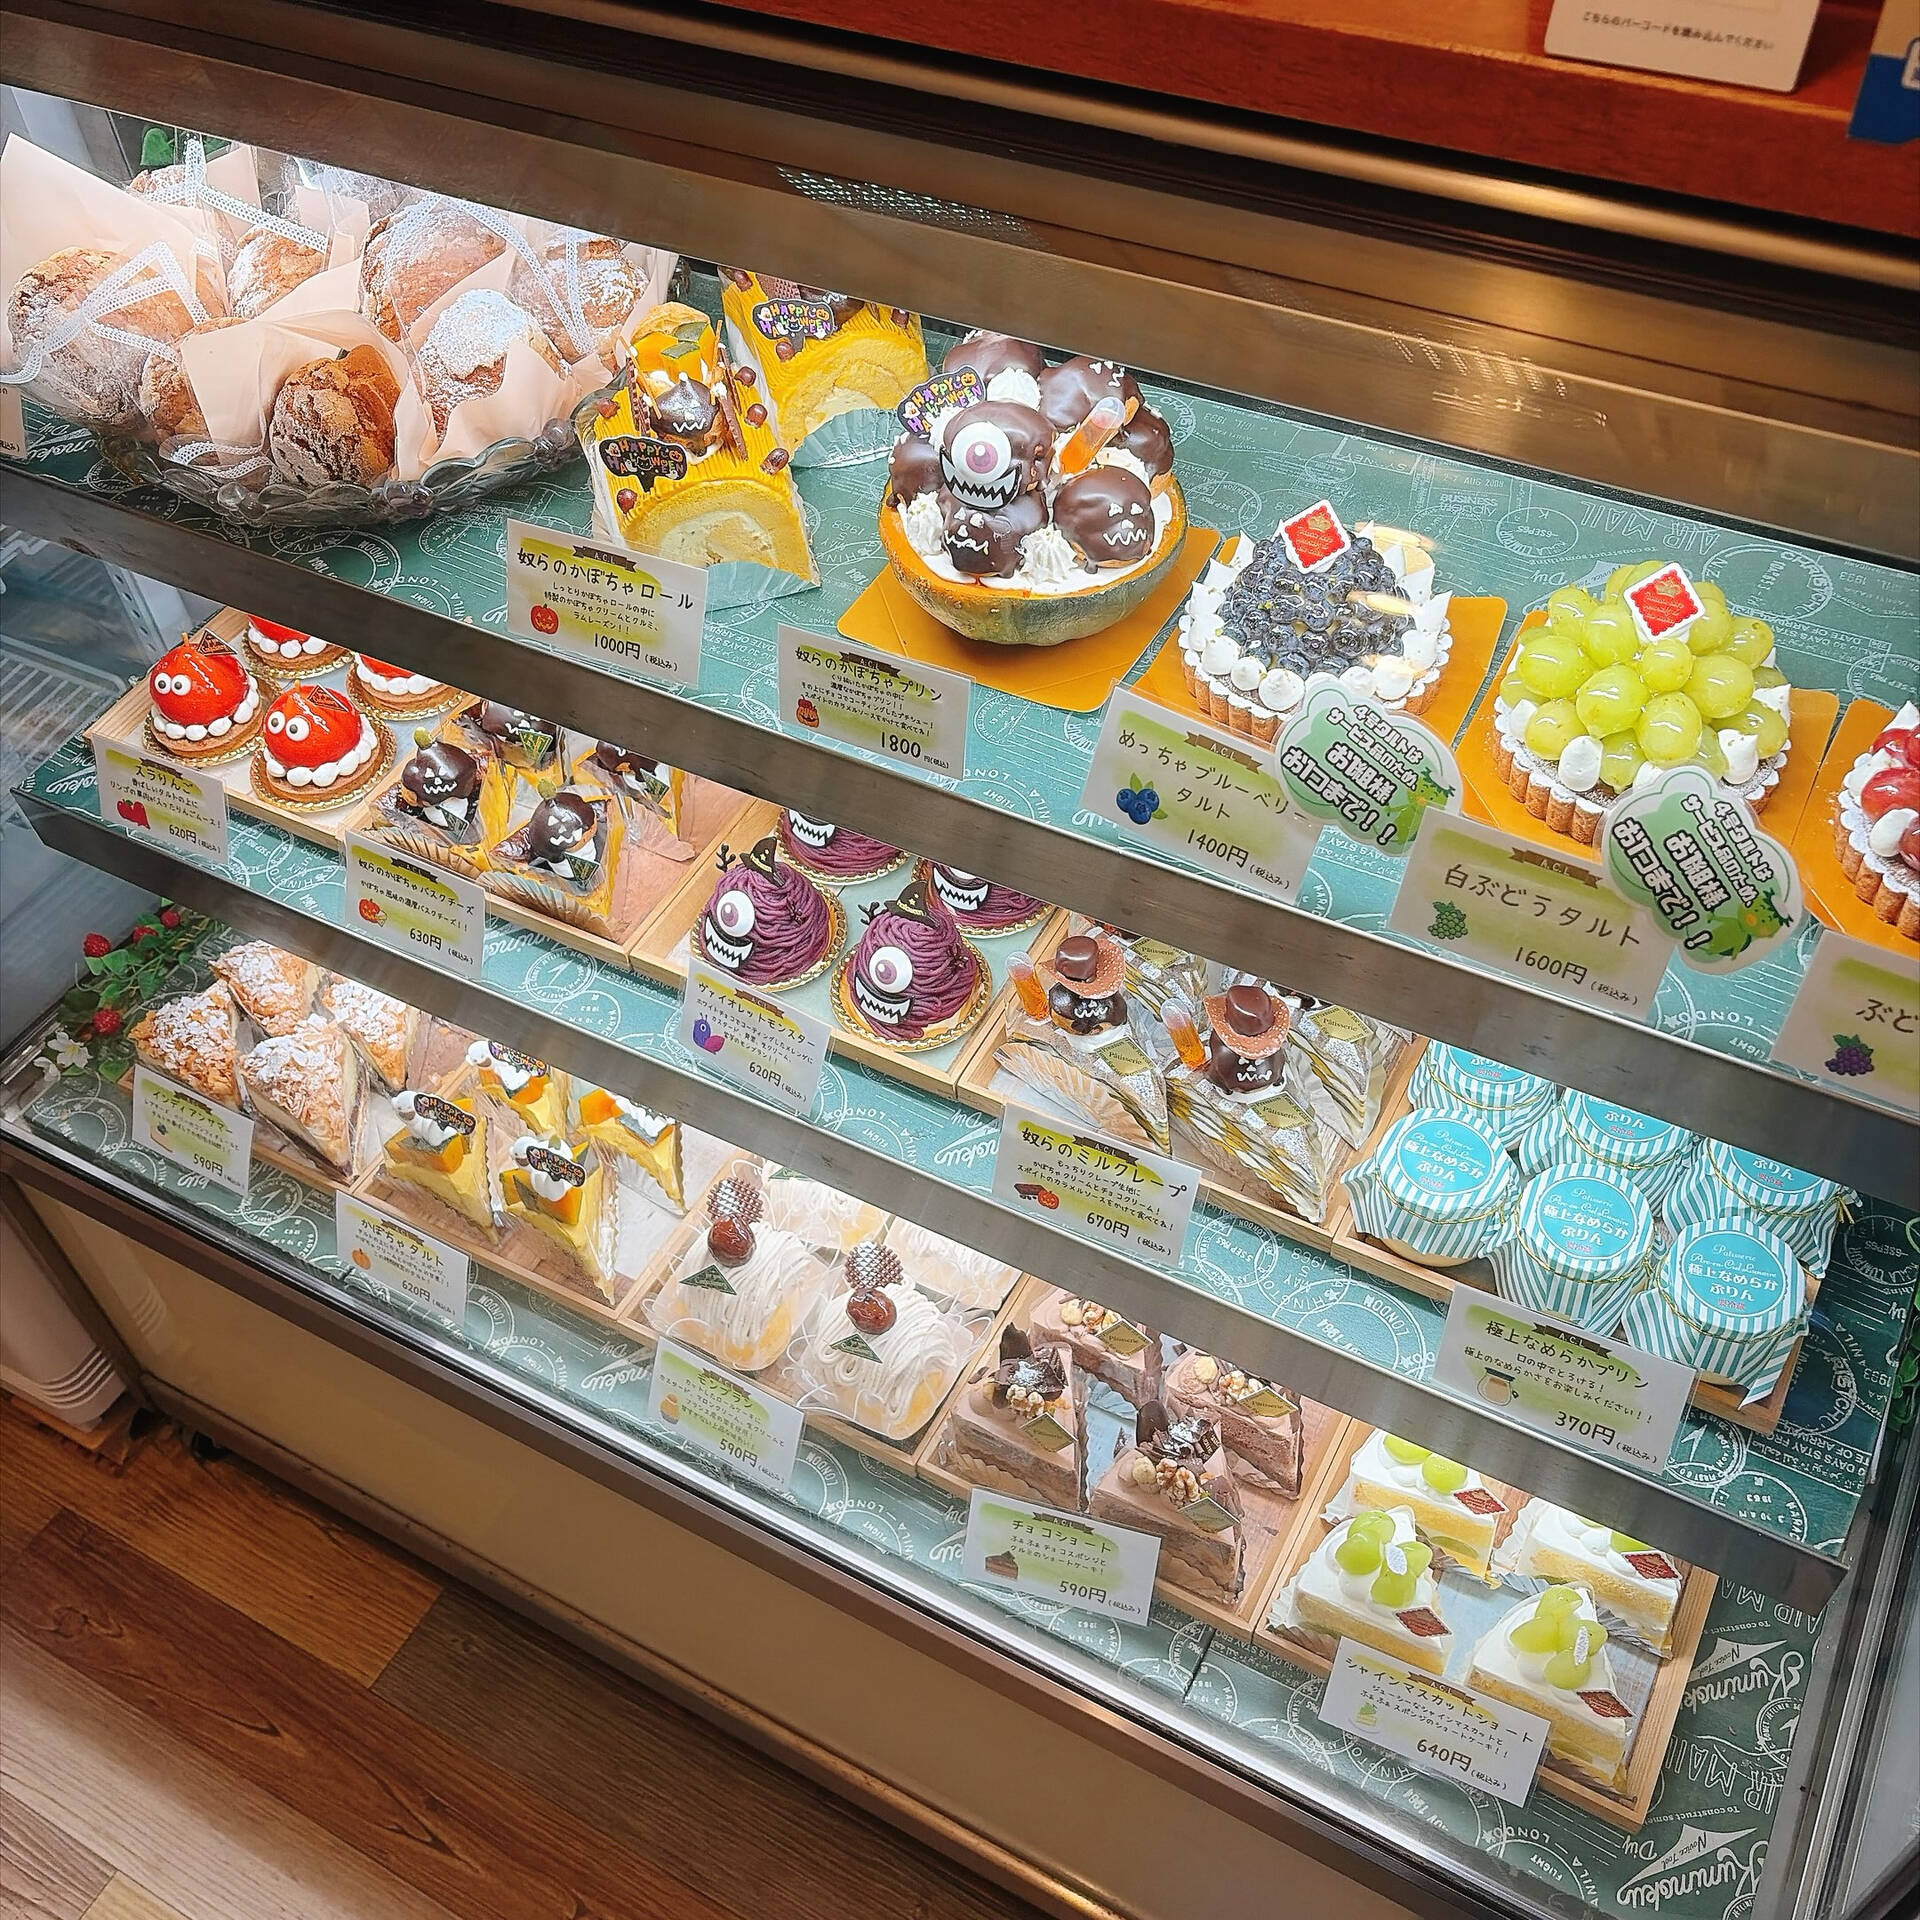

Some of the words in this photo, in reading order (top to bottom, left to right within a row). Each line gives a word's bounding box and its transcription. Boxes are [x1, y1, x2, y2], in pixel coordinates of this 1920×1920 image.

[1581, 499, 1659, 541] MAIL
[517, 547, 694, 610] 奴らのかぼちゃロール
[594, 633, 641, 660] 1000円
[880, 731, 921, 759] 1800
[1353, 704, 1425, 764] 4号タルトは
[1176, 786, 1231, 821] タルト
[168, 824, 197, 844] 620円
[1186, 828, 1249, 868] 1400円
[1713, 801, 1775, 882] 4号タルトは
[1443, 863, 1641, 948] 白ぶどうタルト
[409, 928, 442, 950] 630円
[1513, 947, 1589, 985] 1600円
[749, 1062, 782, 1087] 620円
[193, 1153, 223, 1176] 590円
[1021, 1127, 1188, 1198] 奴らのミルクレープ
[1415, 1161, 1457, 1183] ぷりん
[1086, 1212, 1130, 1239] 670円
[1560, 1225, 1604, 1246] ぷりん
[361, 1219, 444, 1267] かぼちゃタルト
[401, 1280, 431, 1302] 620円
[1688, 1263, 1779, 1291] 極上なめらか
[1709, 1283, 1754, 1302] ぷりん
[1485, 1320, 1649, 1390] 極上なめらかプリン
[697, 1373, 753, 1408] モンブラン
[1554, 1411, 1616, 1446] 370円
[719, 1438, 758, 1467] 590円
[1011, 1520, 1112, 1553] チョコショート
[1058, 1580, 1107, 1604] 590円
[1345, 1657, 1534, 1744] シャインマスカットショート
[1416, 1739, 1472, 1772] 640円
[1725, 1806, 1741, 1815] To
[1623, 1834, 1658, 1860] Diy
[1680, 1831, 1707, 1854] Novice
